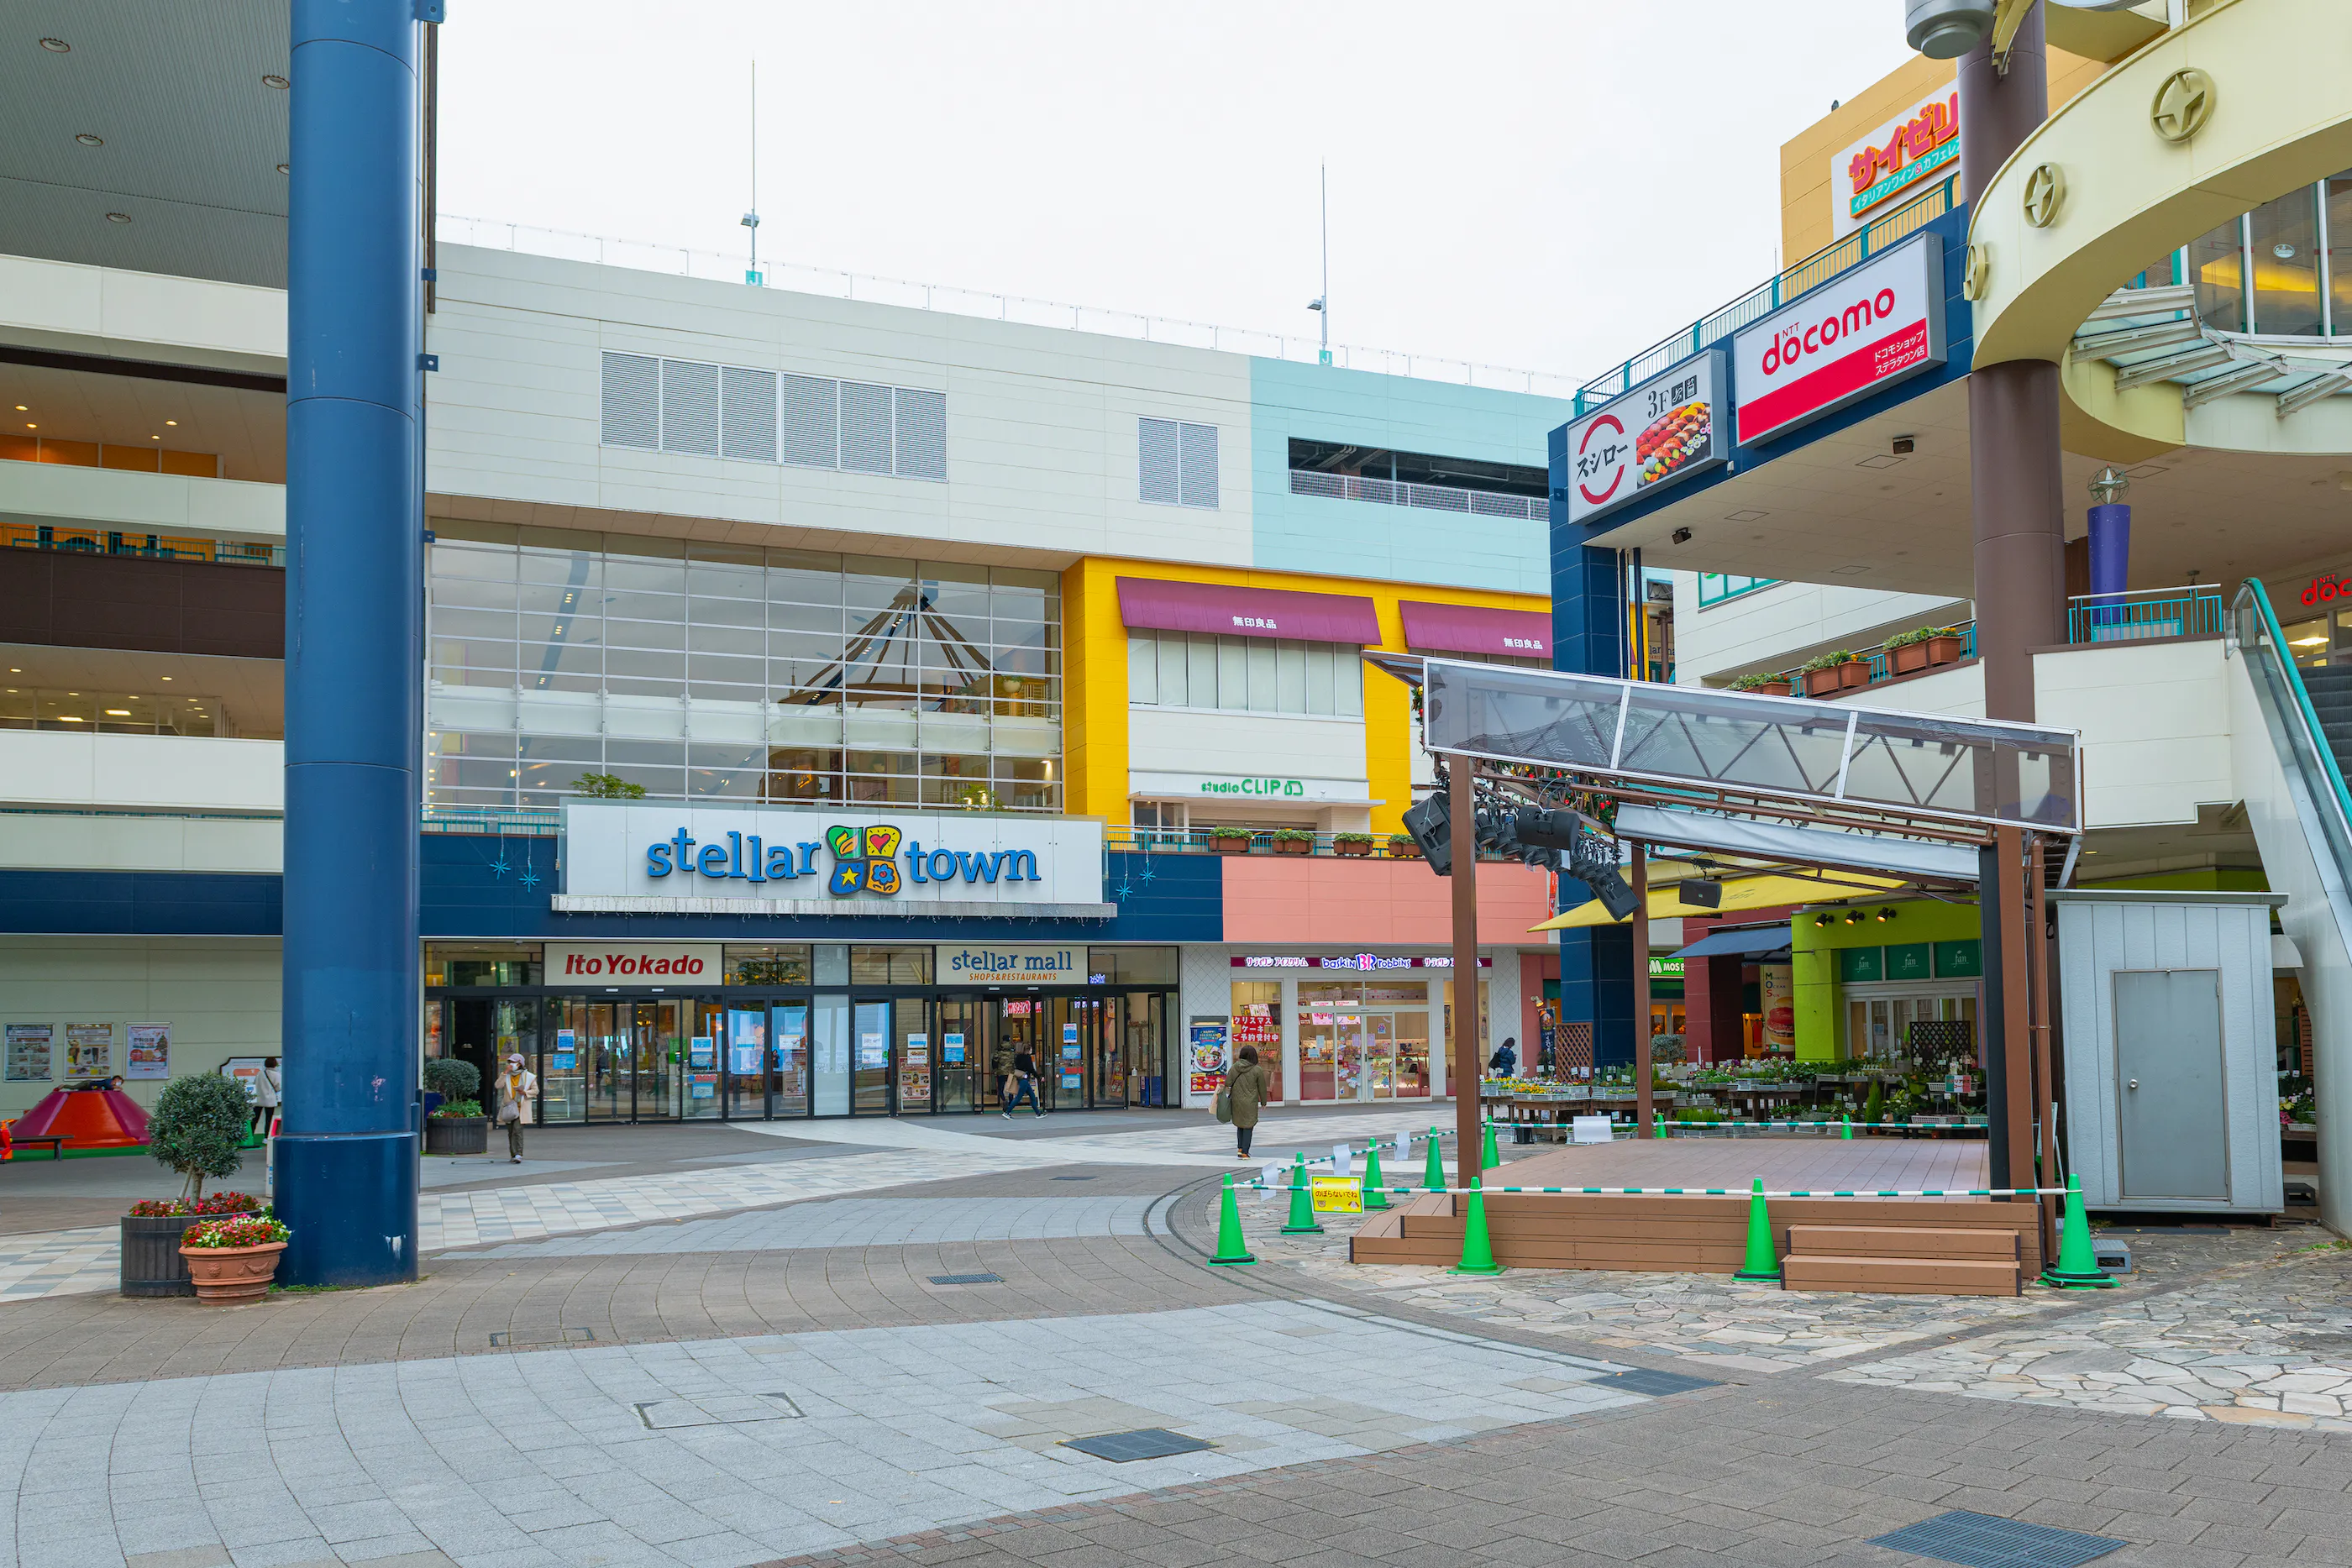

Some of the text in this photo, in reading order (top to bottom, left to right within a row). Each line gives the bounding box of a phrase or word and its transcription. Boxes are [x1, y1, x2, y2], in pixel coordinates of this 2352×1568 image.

[1761, 288, 1895, 375] docomo
[1782, 322, 1800, 338] NTT
[1874, 329, 1924, 363] ドコモショップ
[1875, 344, 1925, 375] ステラタウン店
[1647, 389, 1670, 419] 3F
[1576, 444, 1628, 483] スシロー
[2319, 574, 2336, 584] NTT
[1232, 616, 1277, 629] 無印良品
[1504, 637, 1543, 649] 無印良品
[1201, 779, 1281, 794] studio CLIP
[646, 826, 1042, 884] stellar town
[952, 950, 1074, 972] stellar mall
[1321, 957, 1357, 969] baskin
[1378, 957, 1411, 969] robbins
[1663, 962, 1681, 972] MOS
[969, 973, 1058, 982] SHOPS&RESTAURANTS
[1234, 1016, 1272, 1025] クリスマス
[1242, 1025, 1264, 1033] ケーキ
[1232, 1033, 1278, 1042] ご予約受付中
[1315, 1190, 1357, 1198] のぼらないでね
